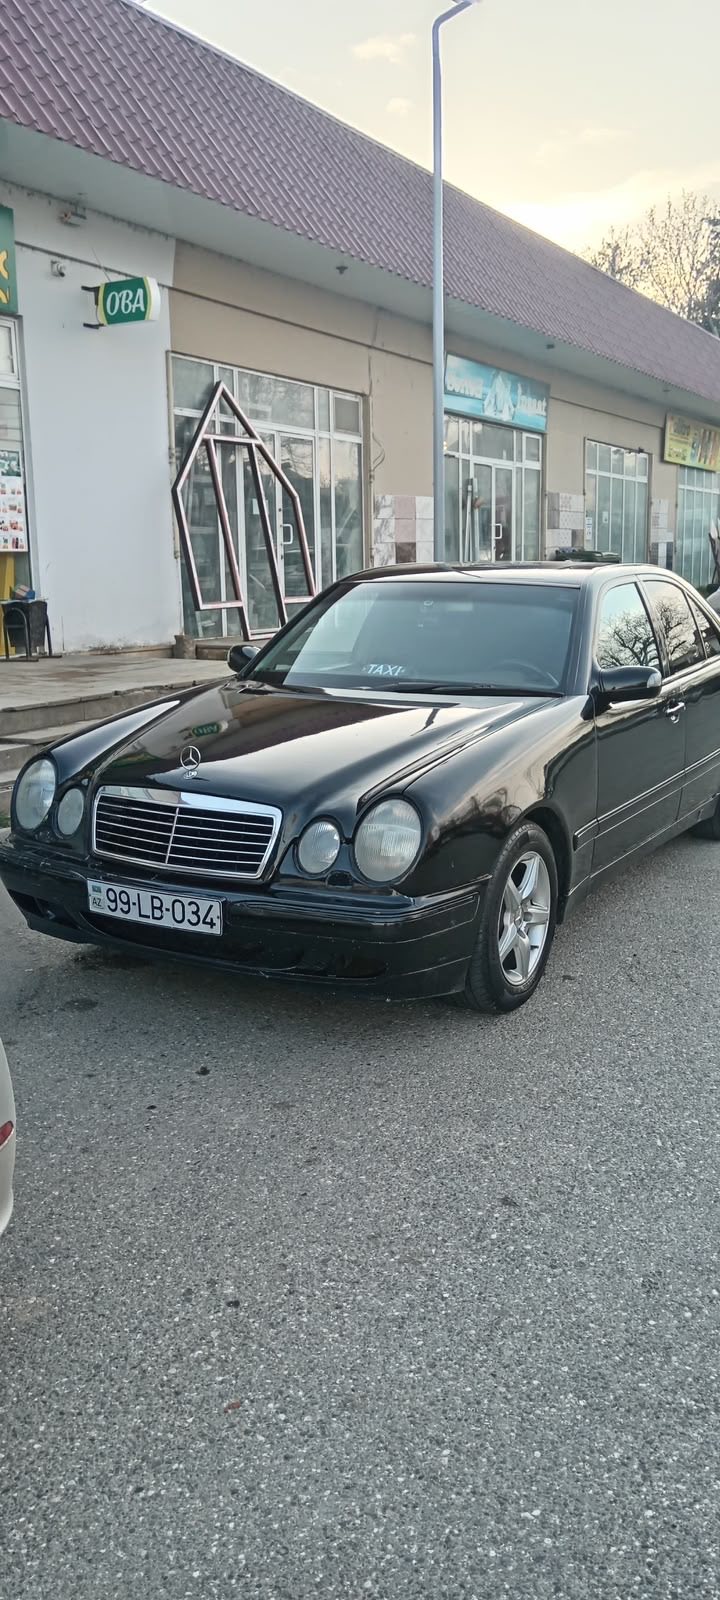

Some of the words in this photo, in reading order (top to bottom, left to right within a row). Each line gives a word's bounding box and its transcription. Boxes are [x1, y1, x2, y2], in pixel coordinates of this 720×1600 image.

[106, 288, 145, 316] OBA
[367, 663, 402, 676] TAXI
[92, 897, 102, 907] AZ
[106, 888, 216, 929] 99-LB-034
